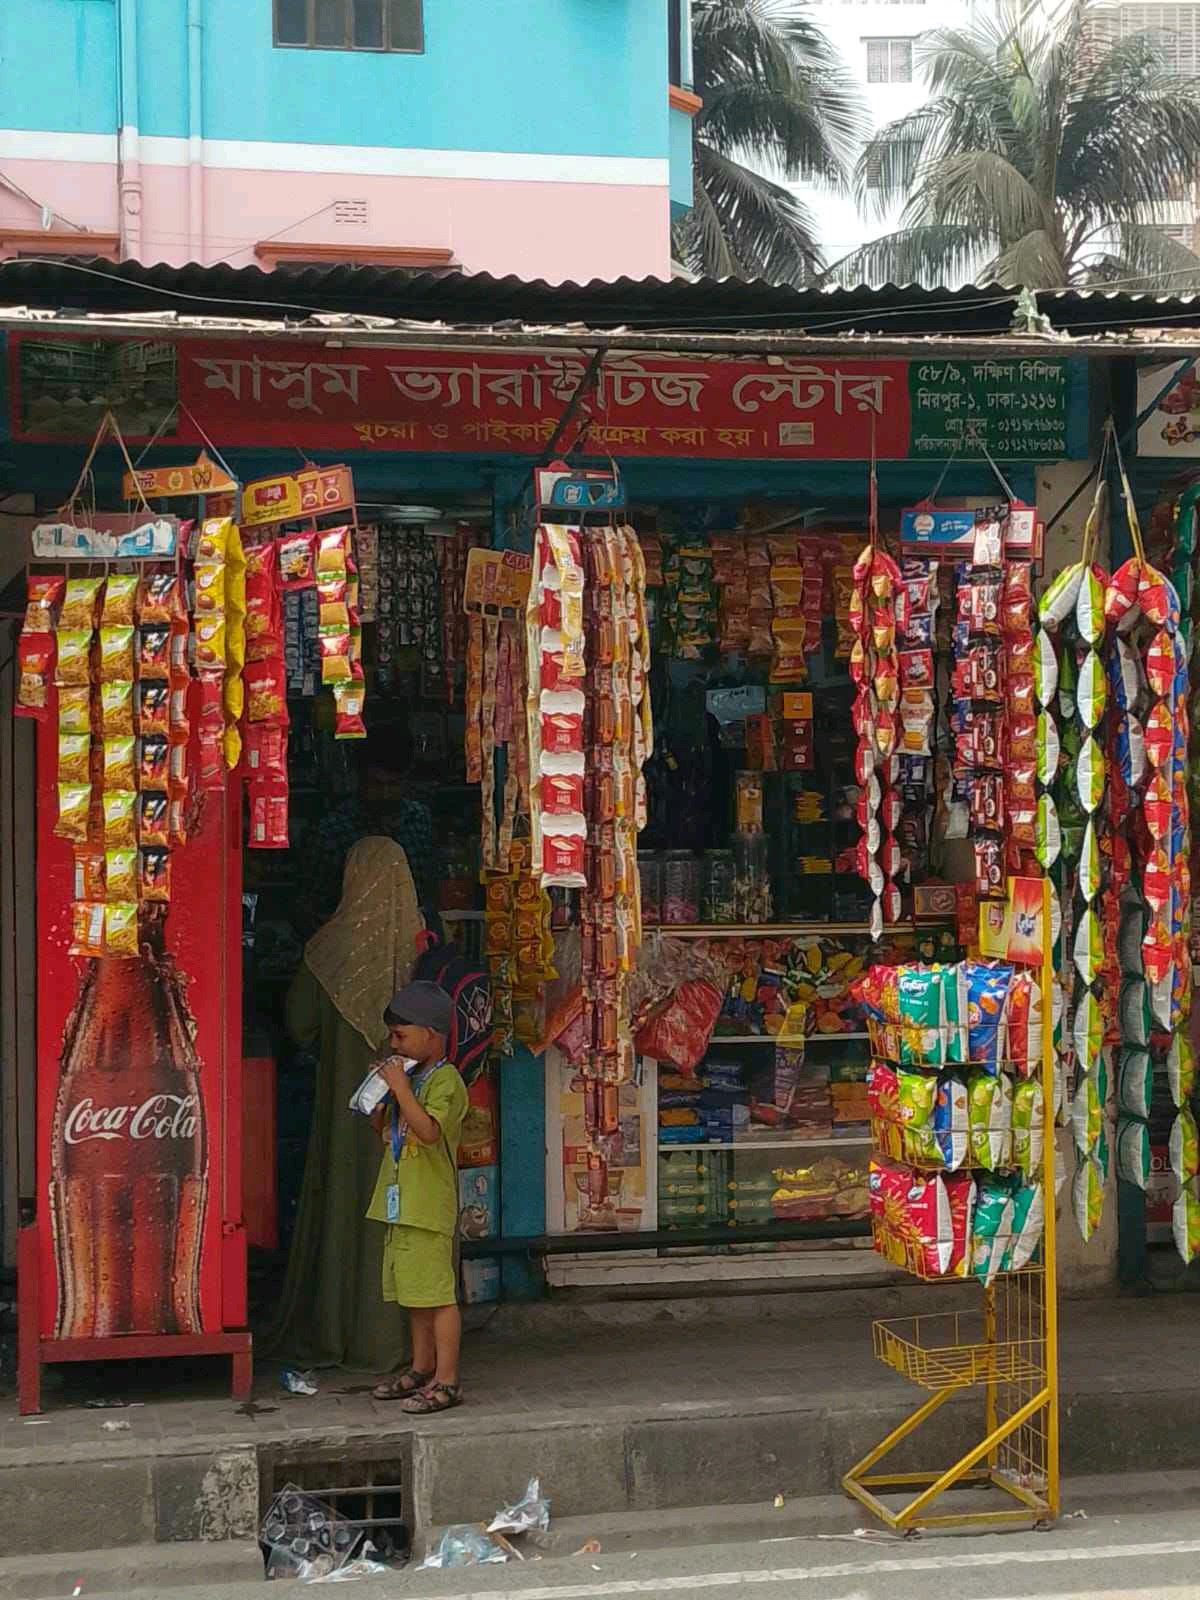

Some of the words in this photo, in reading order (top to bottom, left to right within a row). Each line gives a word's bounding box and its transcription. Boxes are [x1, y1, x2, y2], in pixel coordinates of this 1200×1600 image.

[192, 354, 371, 414] মাসুম
[386, 352, 711, 414] ভ্যারাইটিজ
[732, 358, 893, 416] স্টোর
[972, 360, 1016, 382] দক্ষিণ
[1018, 360, 1066, 384] বিশিল,
[917, 387, 981, 412] মিরপুর-১,
[986, 391, 1057, 410] ঢাকা-১২১৬
[353, 422, 417, 443] খুচরা
[428, 424, 449, 440] ও
[656, 426, 706, 447] করা
[714, 428, 754, 448] হয়
[63, 1094, 199, 1145] Coca-Cola
